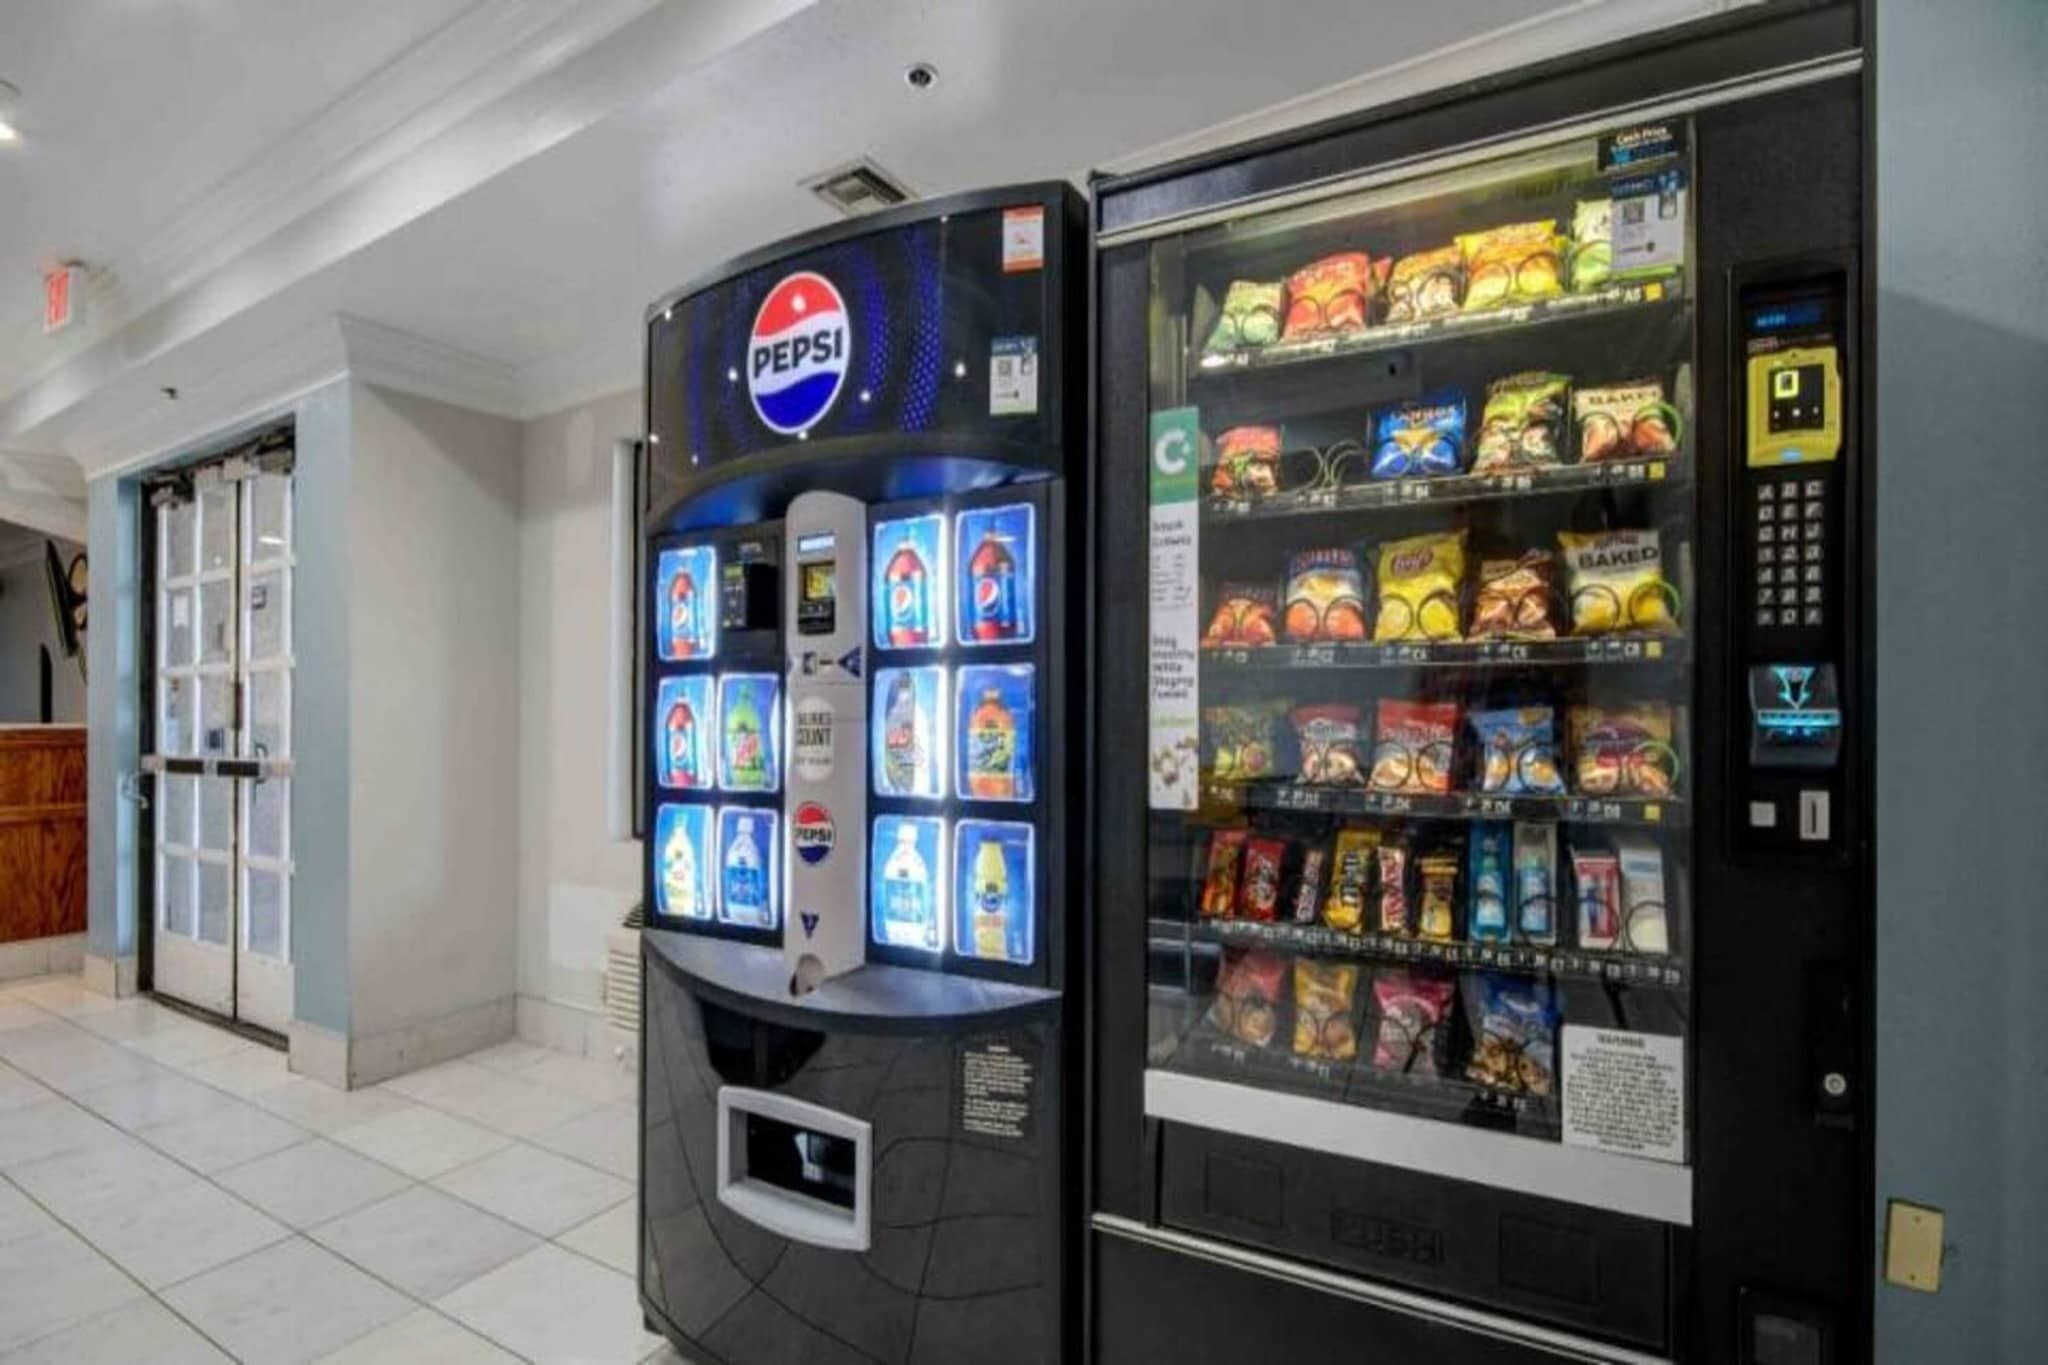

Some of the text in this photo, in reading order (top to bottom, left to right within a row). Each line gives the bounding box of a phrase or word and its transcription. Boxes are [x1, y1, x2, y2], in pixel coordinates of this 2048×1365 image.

[752, 329, 844, 379] PEPSI
[1578, 545, 1659, 570] BAKED
[796, 726, 833, 747] COUNT
[796, 826, 833, 843] PEPSI
